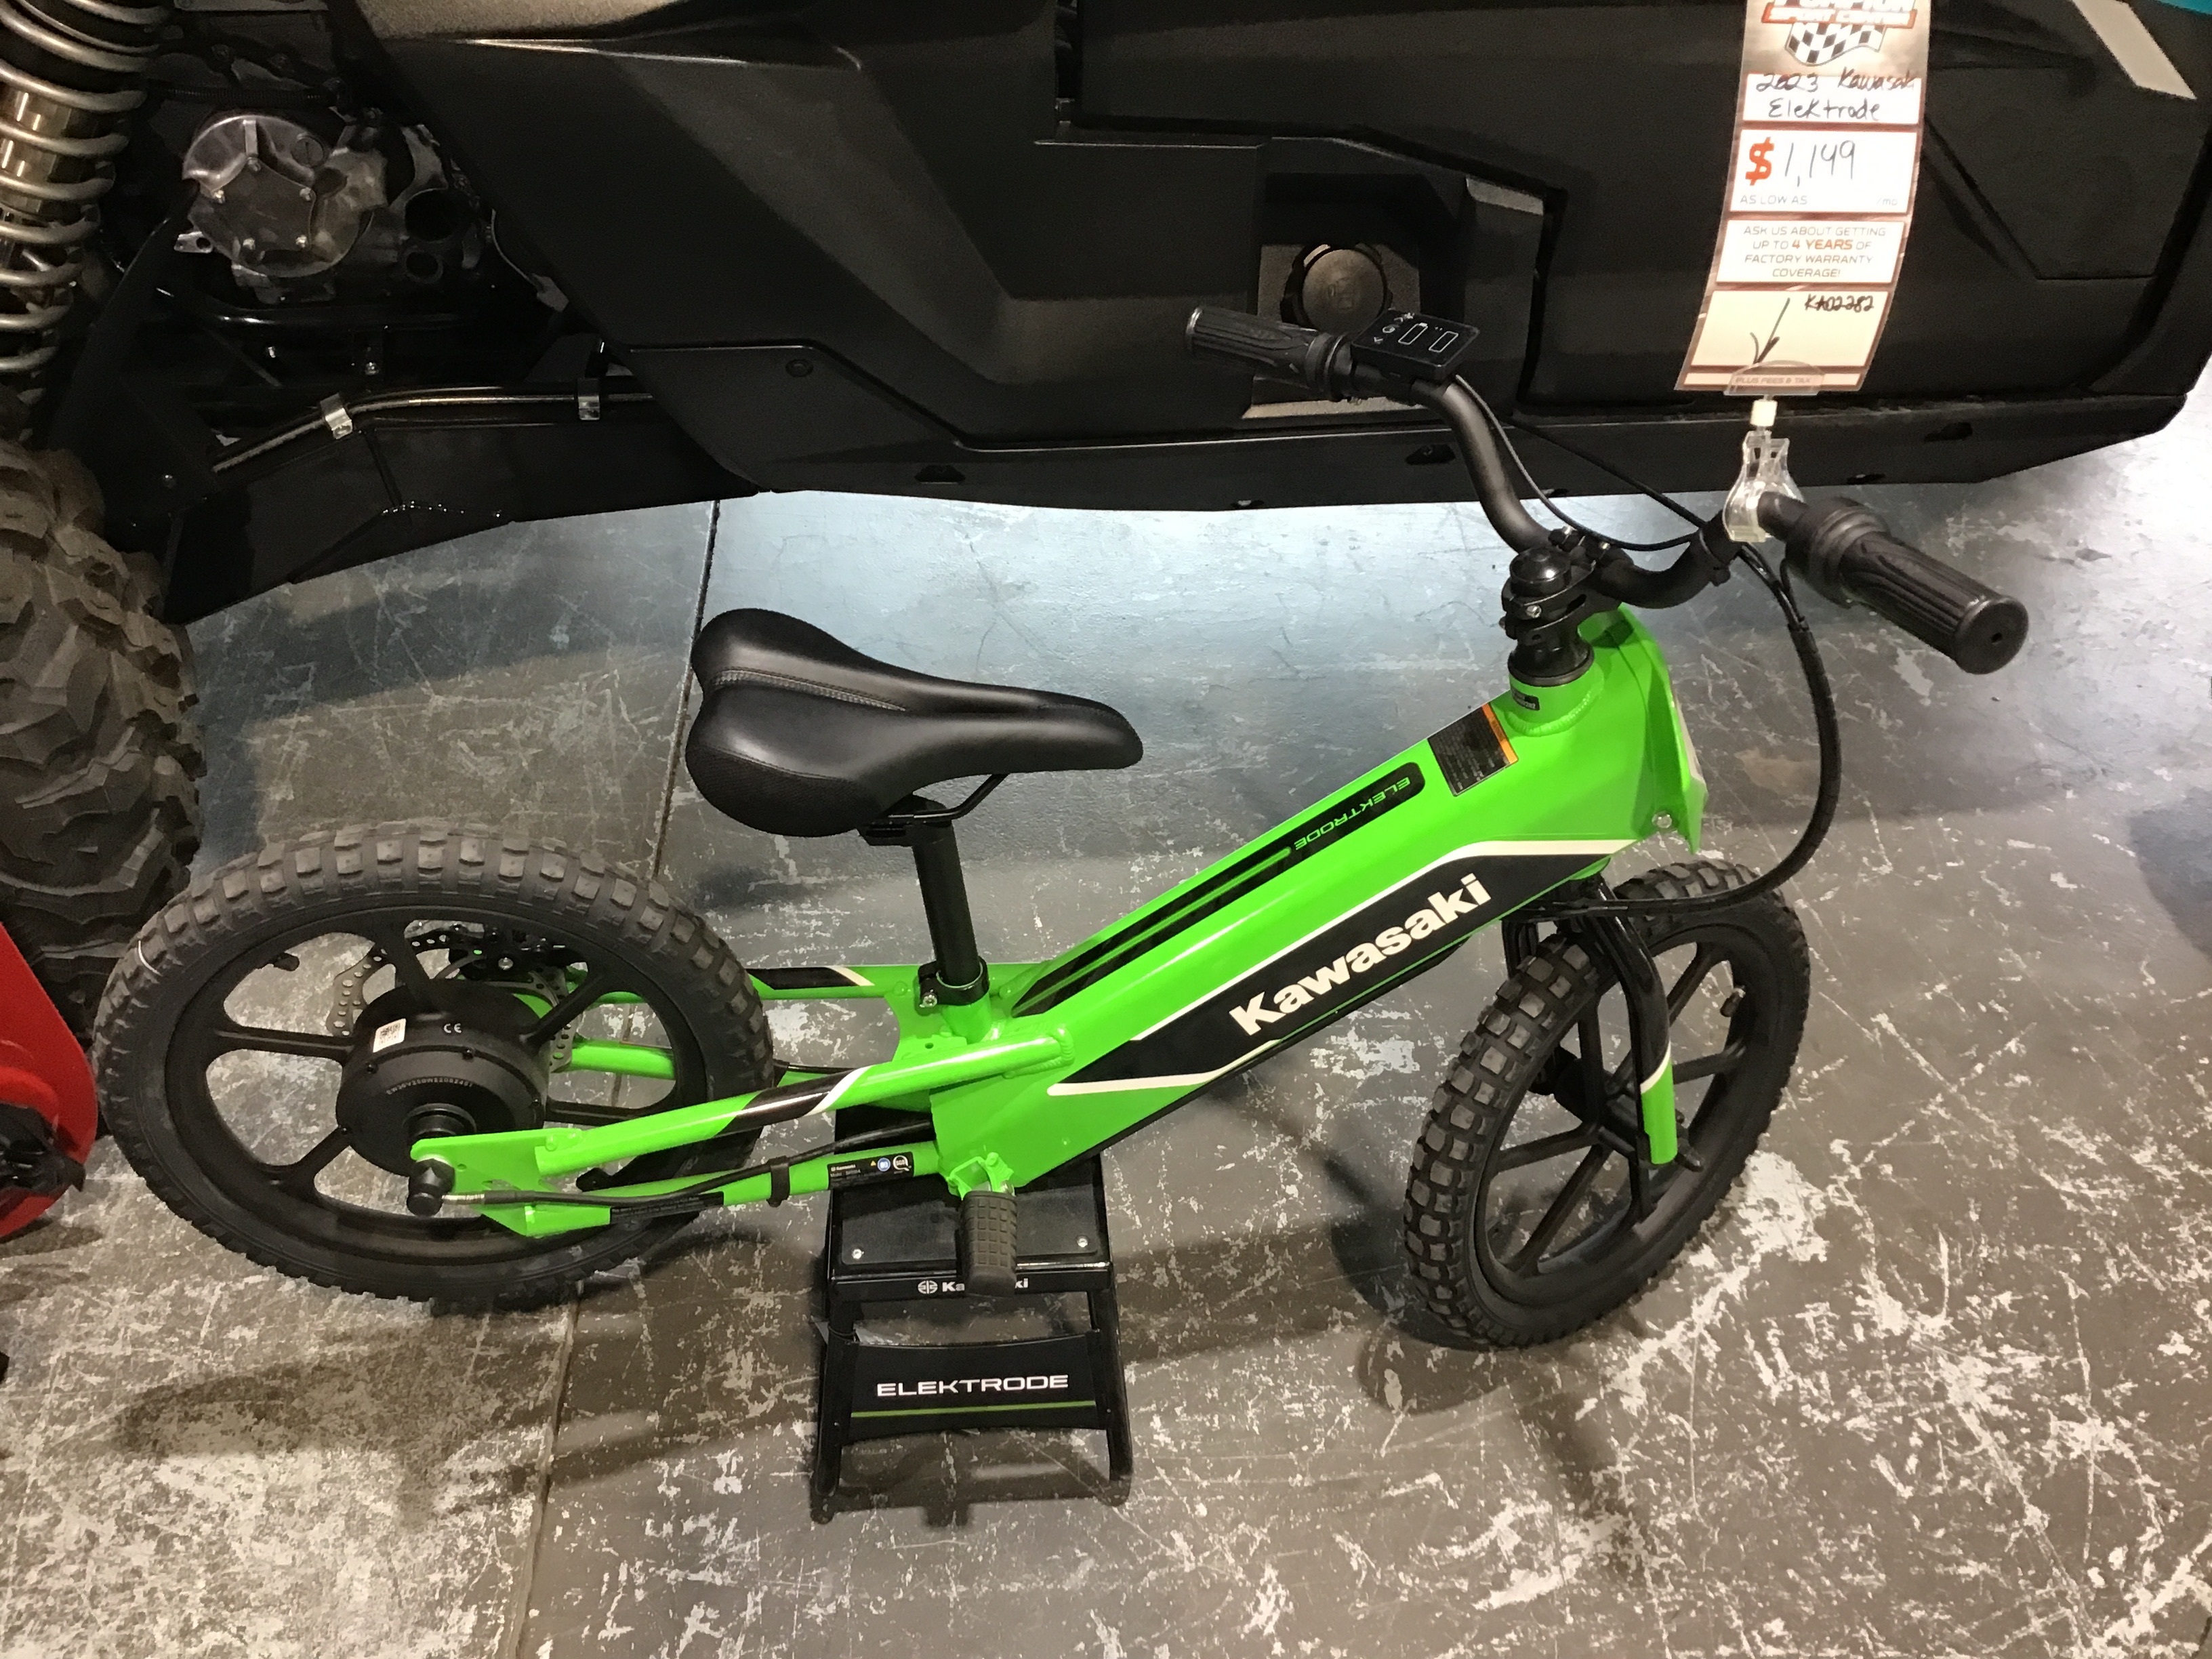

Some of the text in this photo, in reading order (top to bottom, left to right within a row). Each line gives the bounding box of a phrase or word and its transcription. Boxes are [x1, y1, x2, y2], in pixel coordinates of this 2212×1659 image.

[1756, 73, 1818, 92] 2023
[1745, 137, 1856, 188] $ 1,149
[1740, 194, 1807, 205] AS LOW AS
[1744, 226, 1886, 237] ASK US ABOUT GETTING
[1753, 239, 1872, 251] UP TO 4 YEARS OF
[1744, 254, 1873, 264] FACTORY WARRANTY
[1772, 268, 1841, 277] COVERAGE!
[1294, 777, 1411, 851] ELEKTRODE
[1229, 872, 1492, 1036] Kawasaki
[942, 1277, 1029, 1292] Kaki
[877, 1374, 1069, 1397] ELEKTRODE
